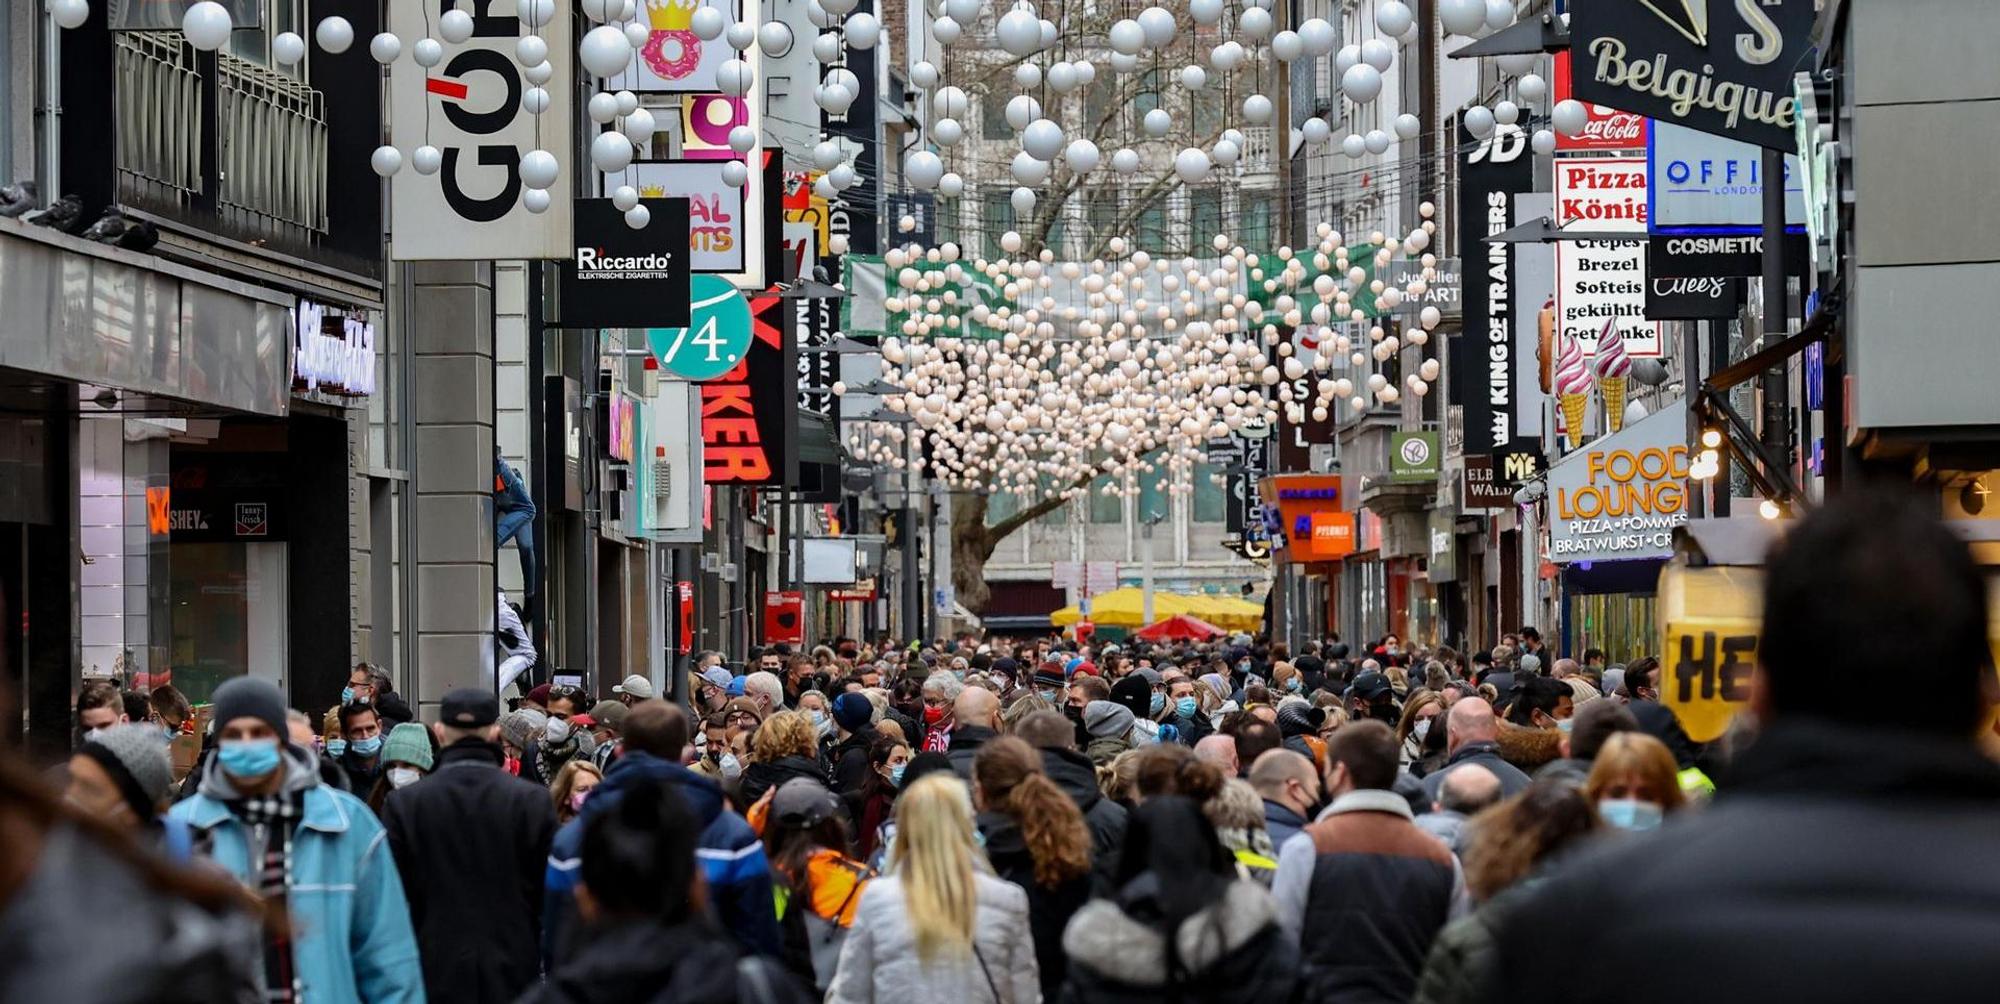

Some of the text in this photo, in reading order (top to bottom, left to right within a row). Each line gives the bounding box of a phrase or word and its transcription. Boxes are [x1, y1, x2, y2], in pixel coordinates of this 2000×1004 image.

[1588, 36, 1796, 129] Belgique
[1566, 167, 1646, 189] Pizza
[1562, 197, 1647, 223] König
[1577, 258, 1639, 271] Brezel
[578, 272, 668, 280] ELEKTRISCHE ZIGARETTEN
[1424, 287, 1460, 302] ART
[1575, 281, 1642, 294] Softeis
[1488, 191, 1509, 404] KING OF TRAINERS
[1564, 326, 1655, 340] Getnke
[1587, 445, 1689, 485] FOOD
[1569, 519, 1613, 535] PIZZA
[1556, 534, 1646, 554] BRATWURST
